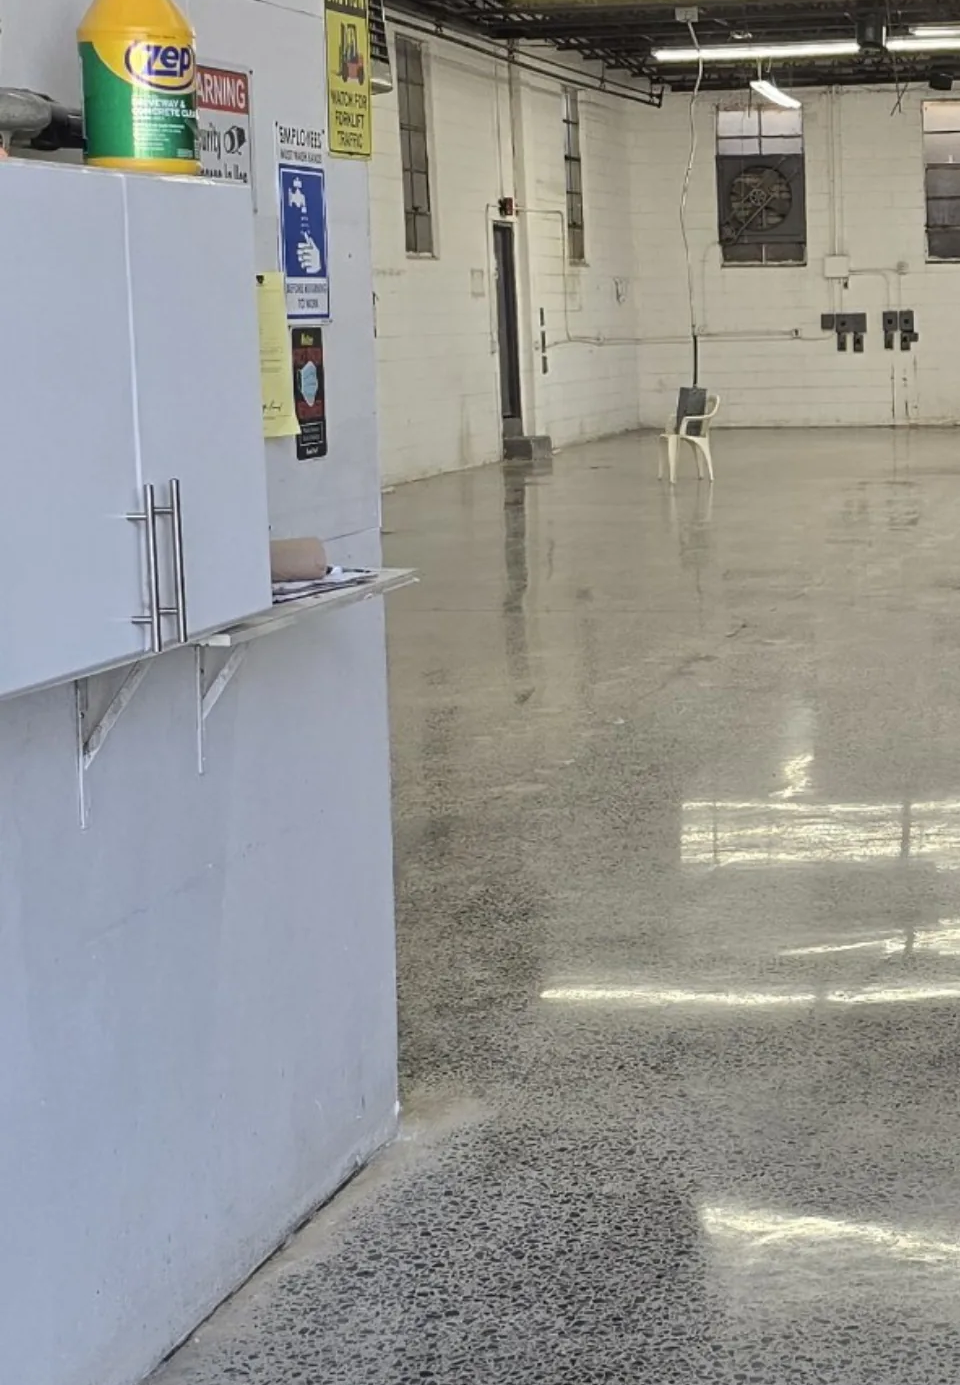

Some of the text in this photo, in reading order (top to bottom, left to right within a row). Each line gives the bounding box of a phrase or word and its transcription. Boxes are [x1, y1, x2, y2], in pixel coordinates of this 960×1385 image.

[197, 72, 246, 109] ARNING
[331, 91, 367, 110] WATCH FOR
[335, 110, 365, 129] FORKLIFT
[201, 122, 221, 160] urity
[279, 126, 322, 149] EMPLOYEES
[337, 131, 363, 149] TRAFFIC
